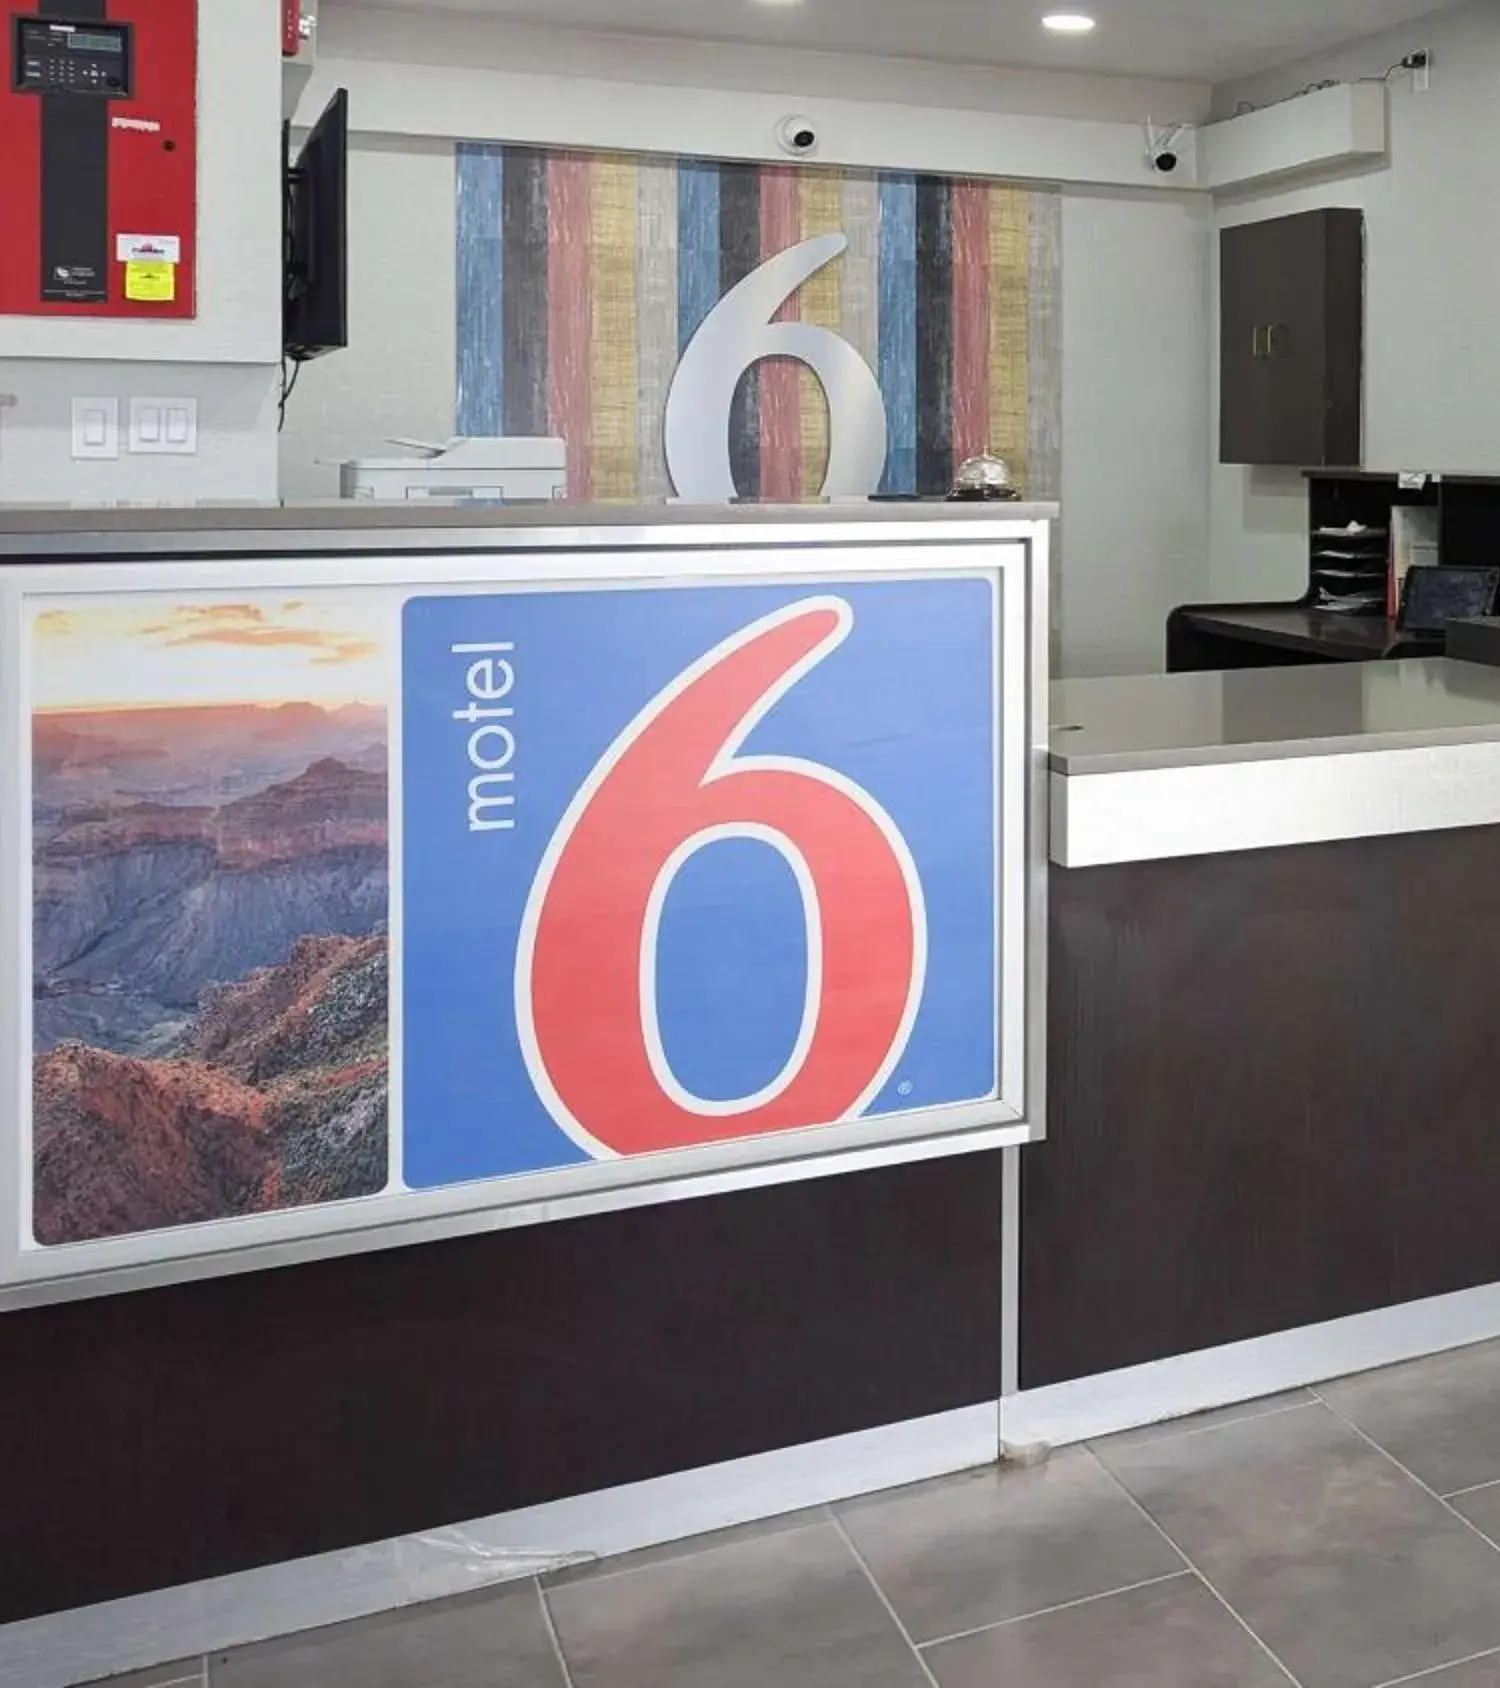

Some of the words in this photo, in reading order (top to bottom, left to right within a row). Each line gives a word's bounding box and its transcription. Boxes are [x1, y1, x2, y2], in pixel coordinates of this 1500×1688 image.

[664, 232, 888, 498] 6
[452, 641, 515, 832] motel
[514, 594, 928, 1160] 6
